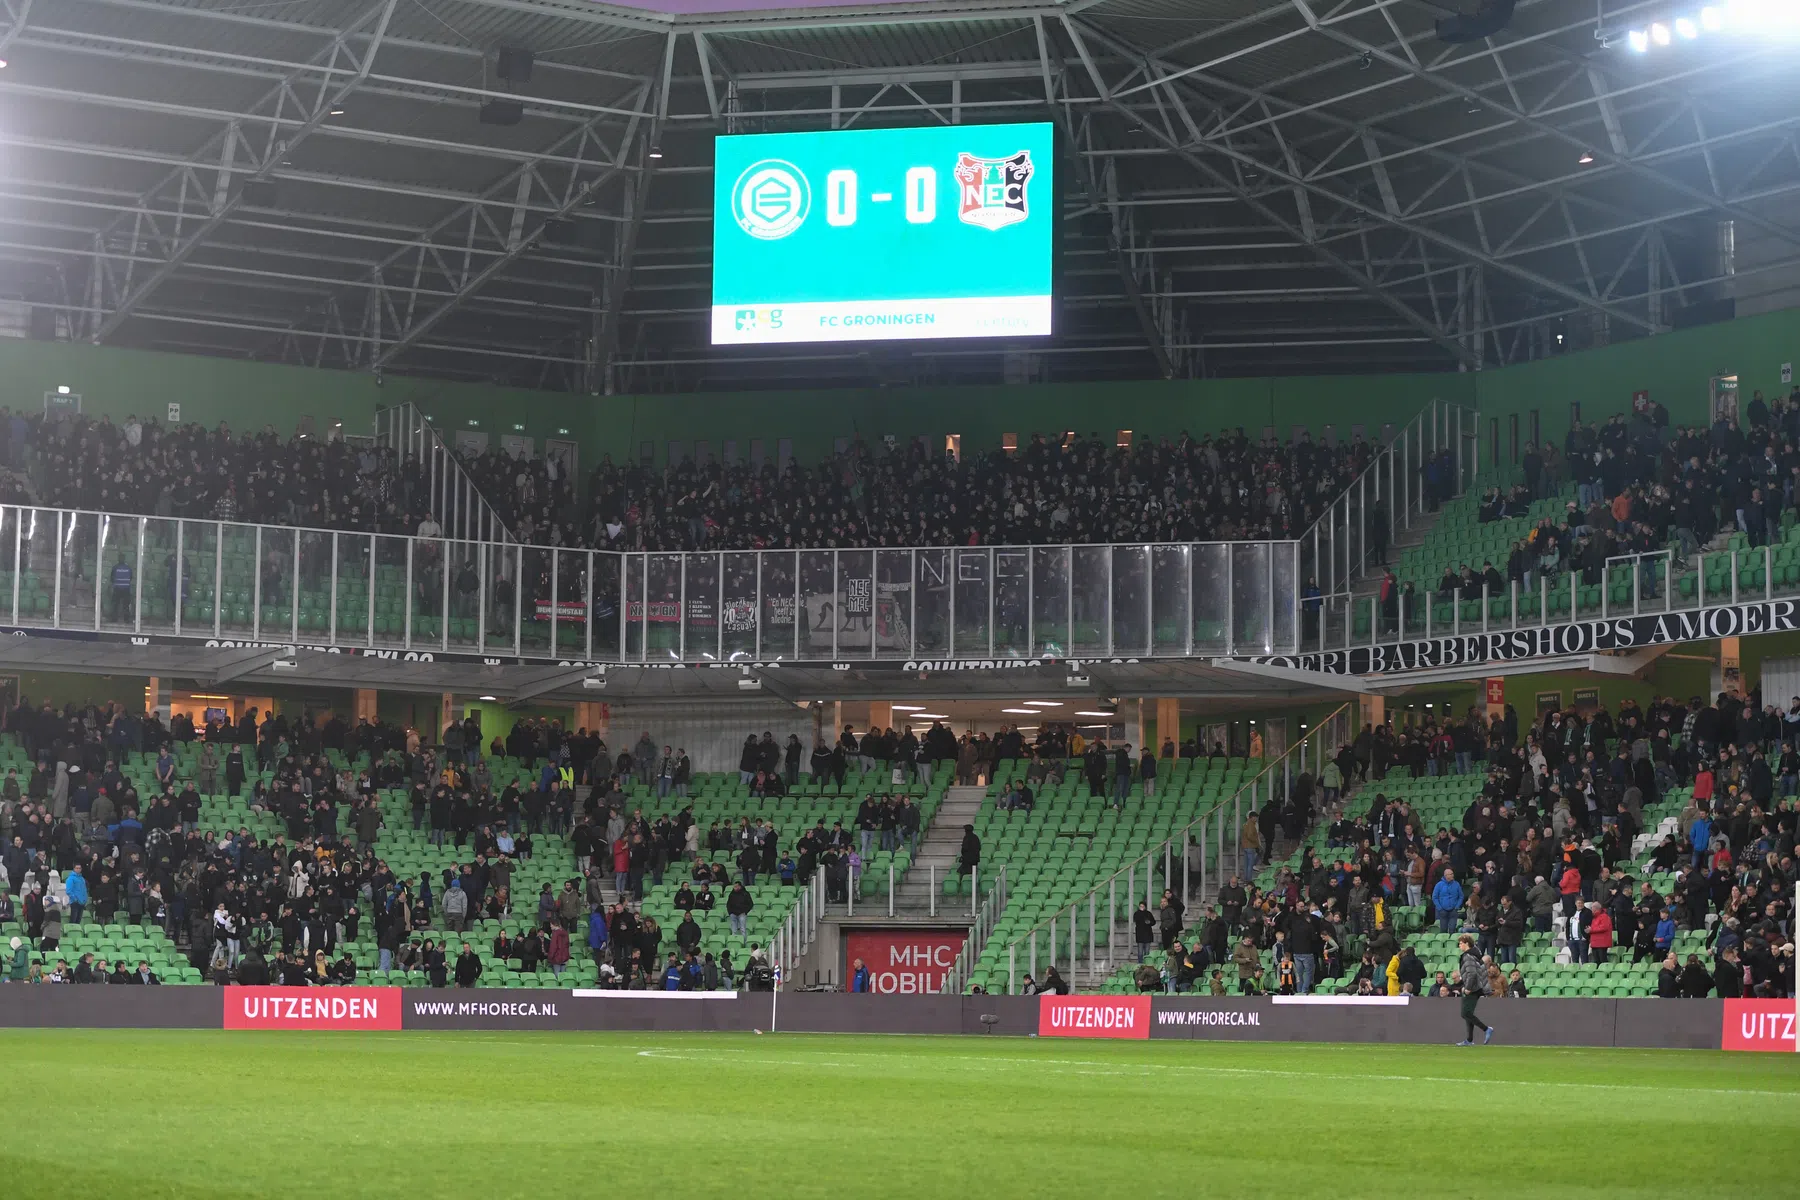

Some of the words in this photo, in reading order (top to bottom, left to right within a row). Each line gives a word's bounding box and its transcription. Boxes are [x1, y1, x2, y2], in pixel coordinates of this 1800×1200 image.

[827, 169, 857, 226] 0
[906, 166, 936, 223] 0
[965, 182, 1022, 207] NEC
[820, 315, 839, 327] FC
[843, 313, 936, 326] GRONINGEN
[848, 578, 870, 597] NEC
[723, 608, 735, 624] 20
[1367, 618, 1635, 673] BARBERSHOPS
[1648, 601, 1797, 644] AMOER
[890, 945, 951, 967] MHC
[244, 997, 378, 1019] UITZENDEN
[414, 1002, 558, 1017] WWW.MFHORECA.NL
[1051, 1006, 1135, 1028] UITZENDEN
[1158, 1011, 1261, 1026] WWW.MFHORECA.NL
[1741, 1012, 1796, 1039] UITZ
